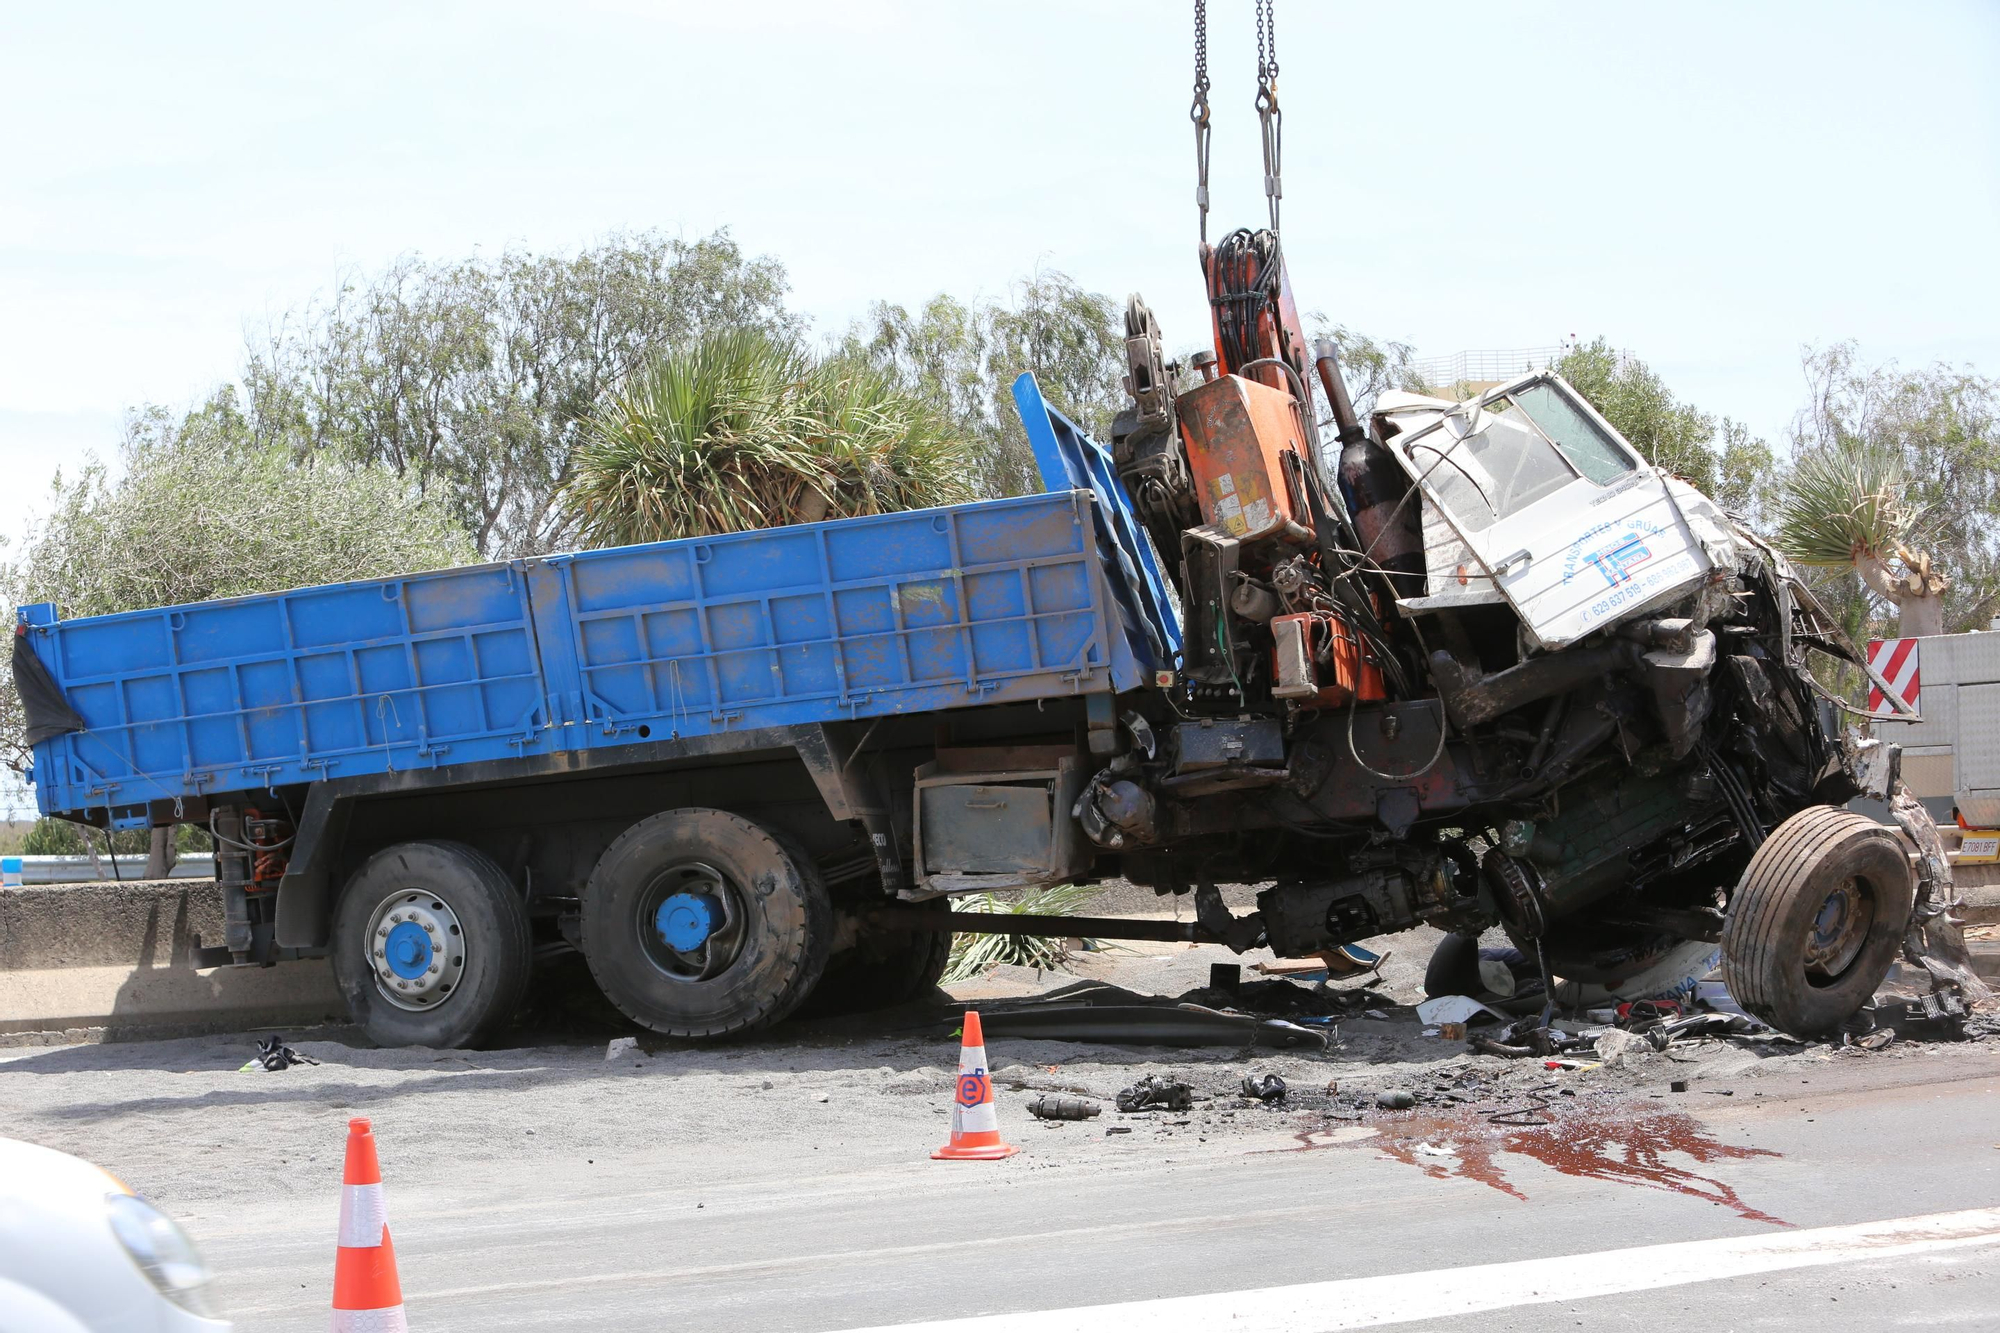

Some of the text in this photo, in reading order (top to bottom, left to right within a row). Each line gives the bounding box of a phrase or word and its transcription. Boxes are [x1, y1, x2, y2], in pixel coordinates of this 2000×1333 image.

[1563, 521, 1612, 586] TRANSPORTES
[1592, 600, 1610, 617] 629
[1609, 591, 1626, 609] 637
[1625, 583, 1642, 599] 519
[1646, 573, 1662, 587] 686
